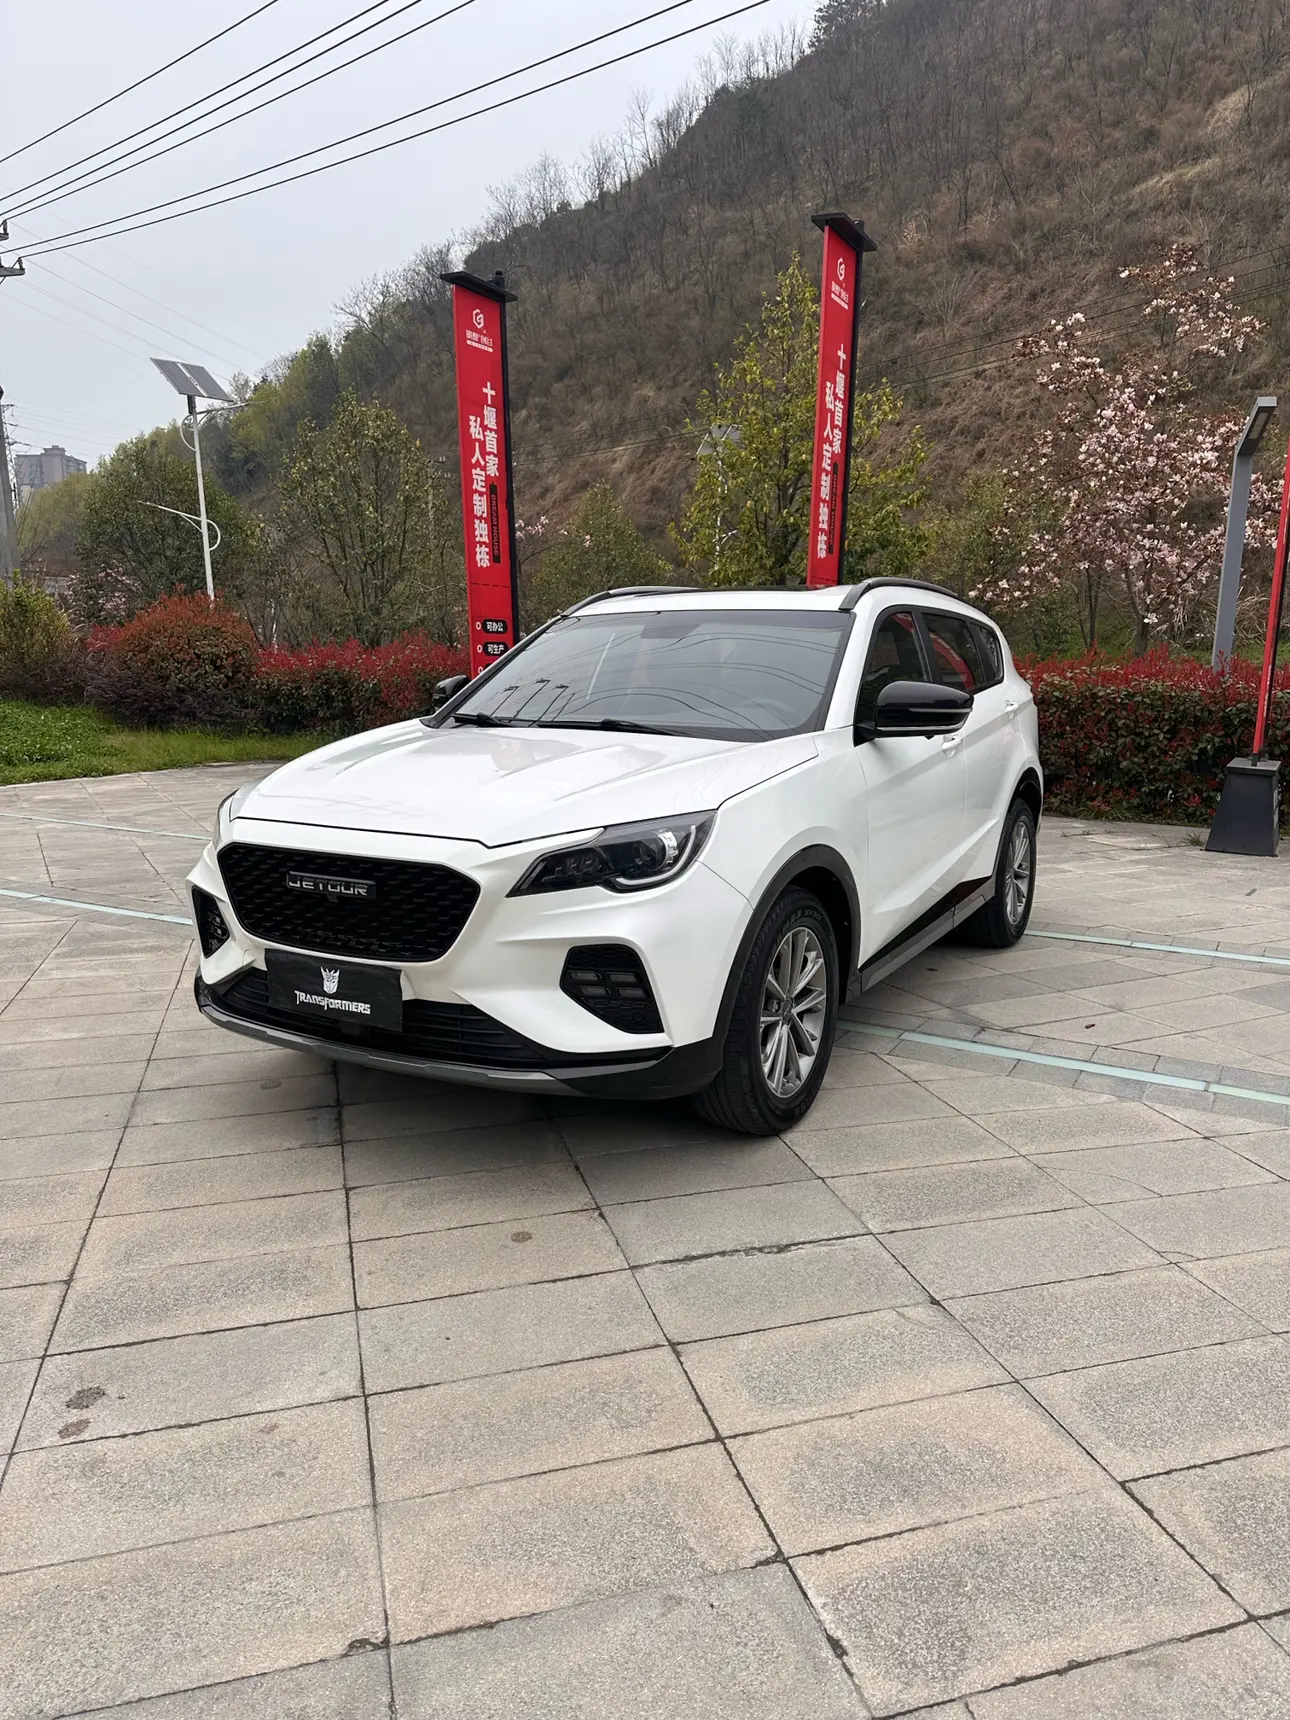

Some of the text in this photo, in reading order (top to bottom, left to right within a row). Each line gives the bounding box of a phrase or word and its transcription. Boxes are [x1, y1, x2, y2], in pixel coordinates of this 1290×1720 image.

[833, 343, 847, 454] 十堰首家
[482, 381, 499, 477] 十堰首家
[817, 381, 835, 559] 私人定制独栋
[468, 415, 490, 568] 私人定制独栋
[492, 526, 500, 556] HOUSE
[486, 621, 504, 632] 可办公
[488, 643, 505, 654] 可生产
[289, 876, 369, 896] JETOUR
[294, 990, 371, 1015] TRANSFORMERS
